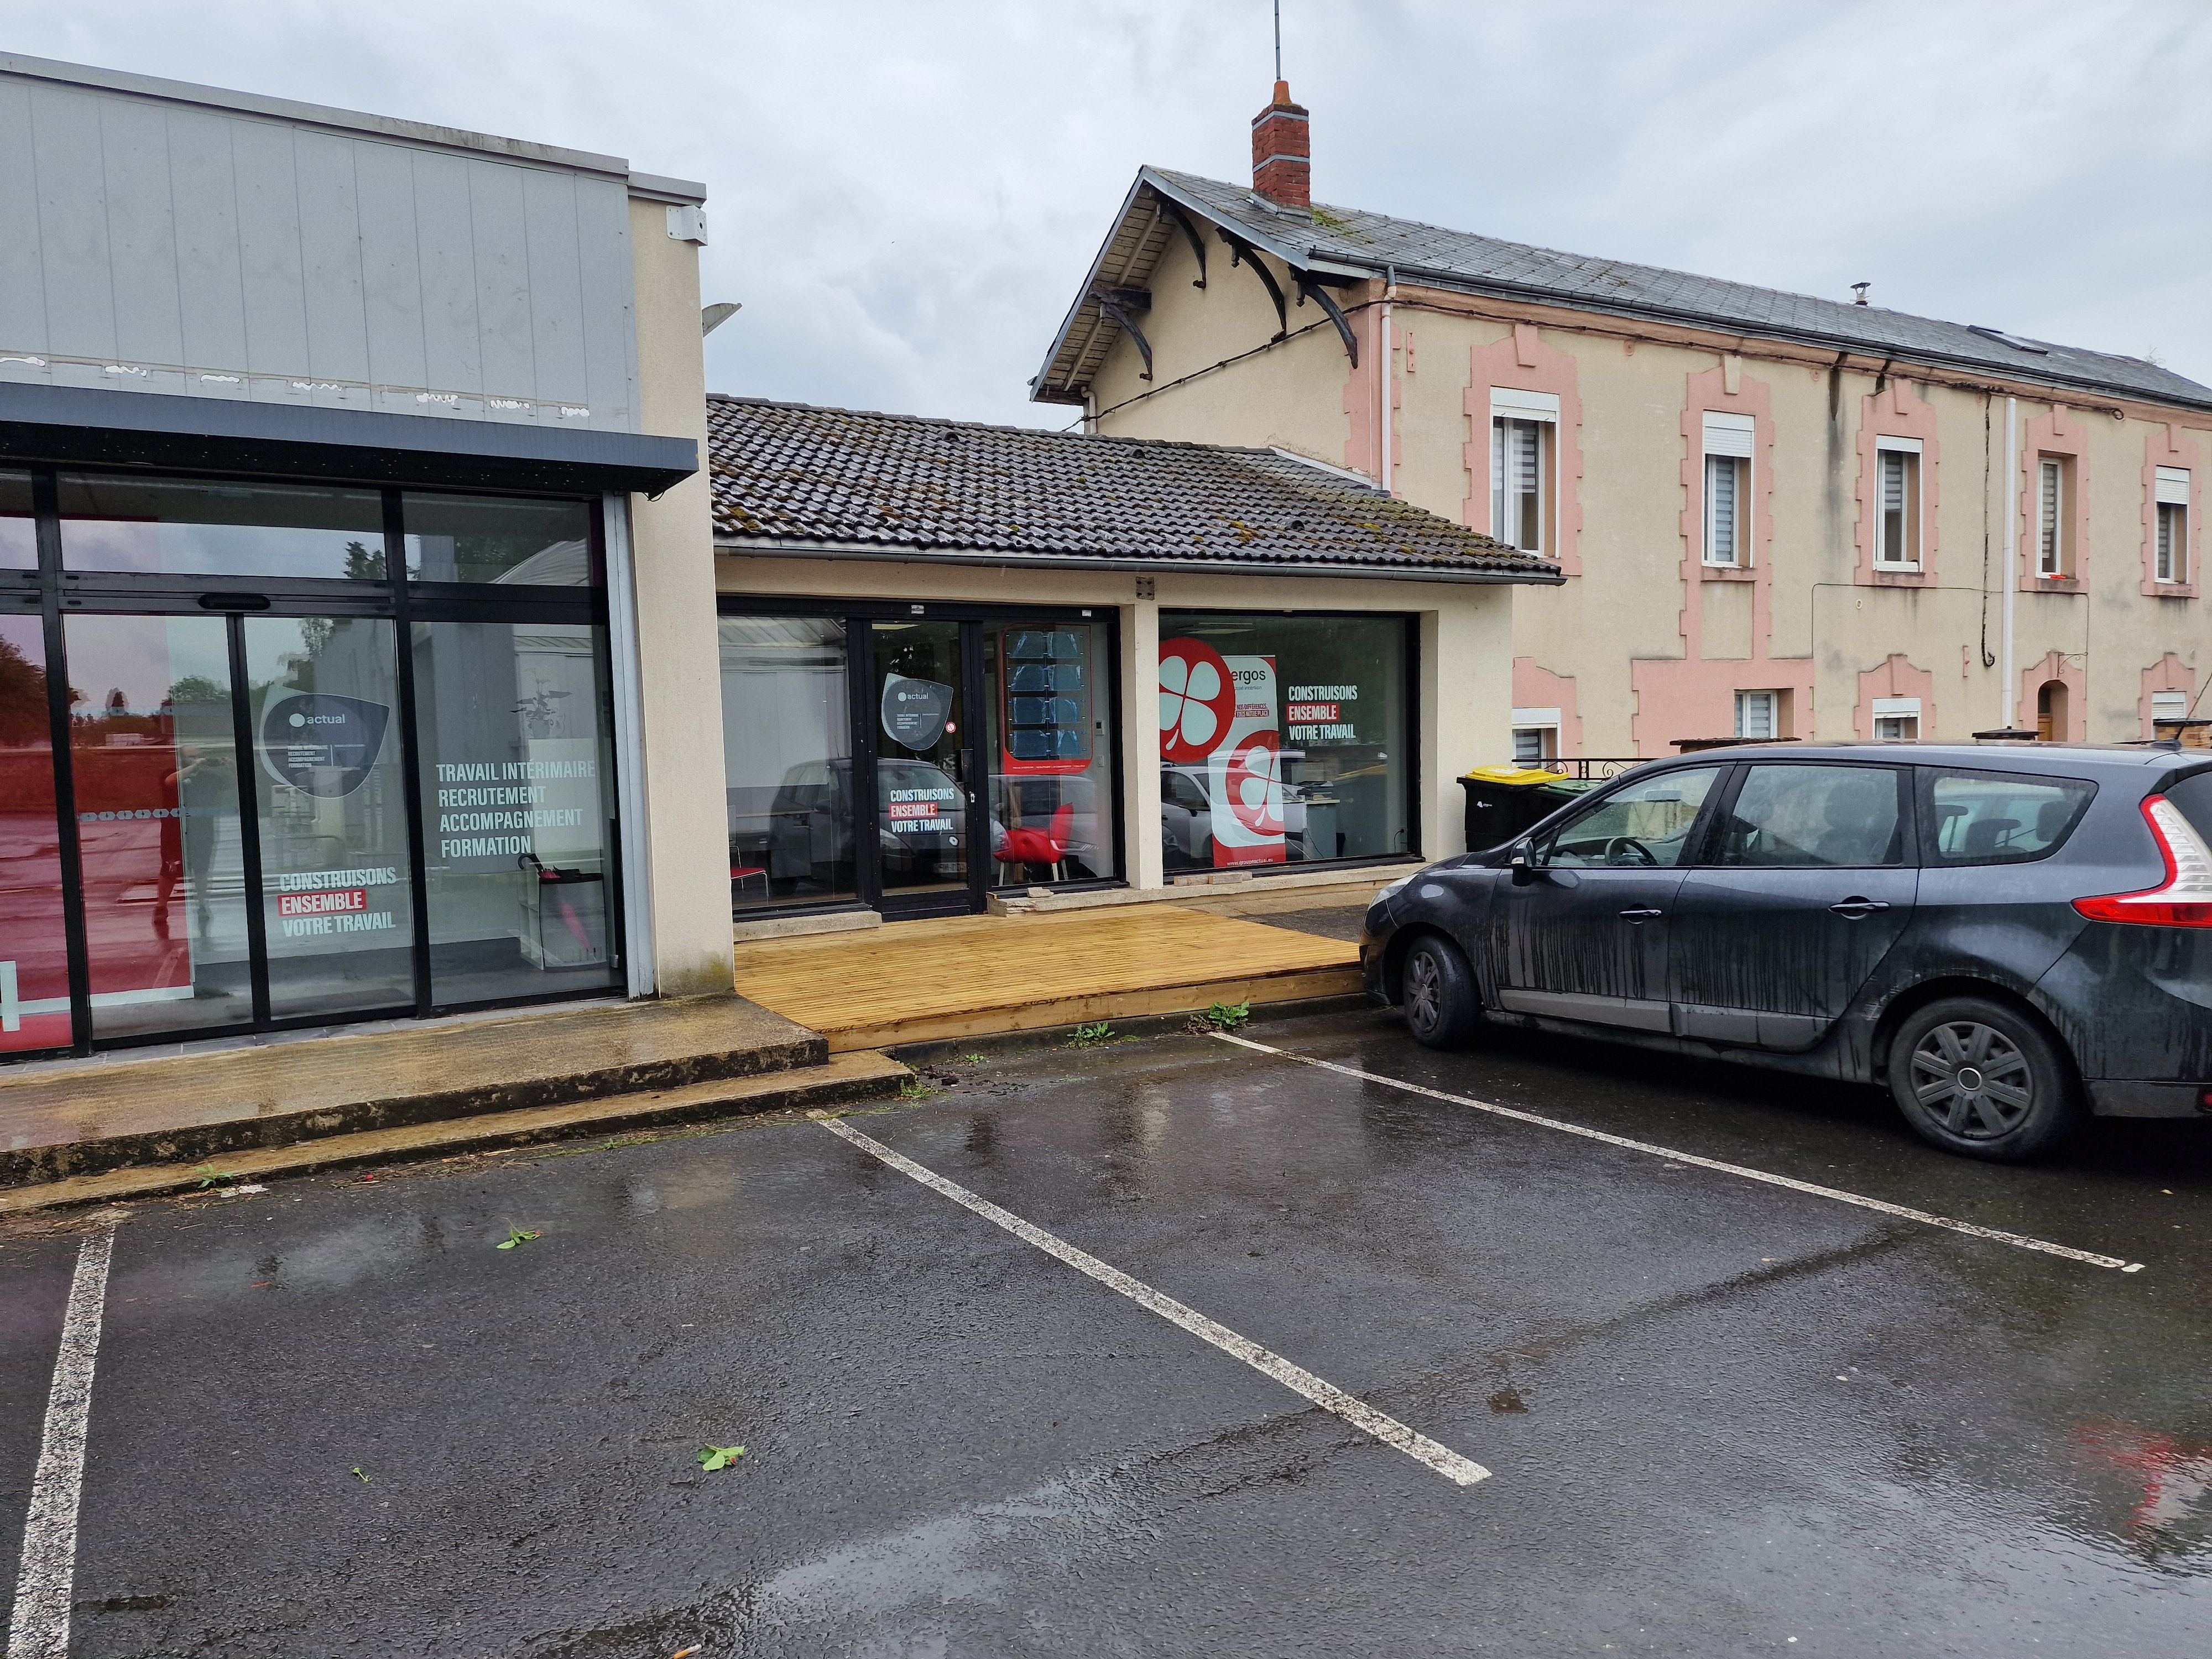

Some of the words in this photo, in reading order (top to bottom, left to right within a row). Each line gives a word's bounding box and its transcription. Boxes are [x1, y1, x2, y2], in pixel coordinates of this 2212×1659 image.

[1230, 670, 1266, 685] ergos
[907, 692, 928, 700] actual
[1288, 685, 1358, 701] CONSTRUISONS
[307, 713, 346, 724] actual
[1288, 705, 1337, 721] ENSEMBLE
[1288, 724, 1318, 740] VOTRE
[1319, 724, 1357, 739] TRAVAIL
[435, 763, 499, 782] TRAVAIL
[502, 758, 596, 780] INTÉRIMAIRE
[438, 785, 546, 807] RECRUTEMENT
[890, 787, 954, 802] CONSTRUISONS
[890, 804, 936, 817] ENSEMBLE
[439, 808, 583, 832] ACCOMPAGNEMENT
[891, 820, 919, 833] VOTRE
[919, 818, 954, 832] TRAVAIL
[441, 835, 531, 858] FORMATION
[280, 867, 397, 892] CONSTRUISONS
[281, 891, 363, 915] ENSEMBLE
[282, 916, 333, 937] VOTRE
[333, 911, 396, 933] TRAVAIL
